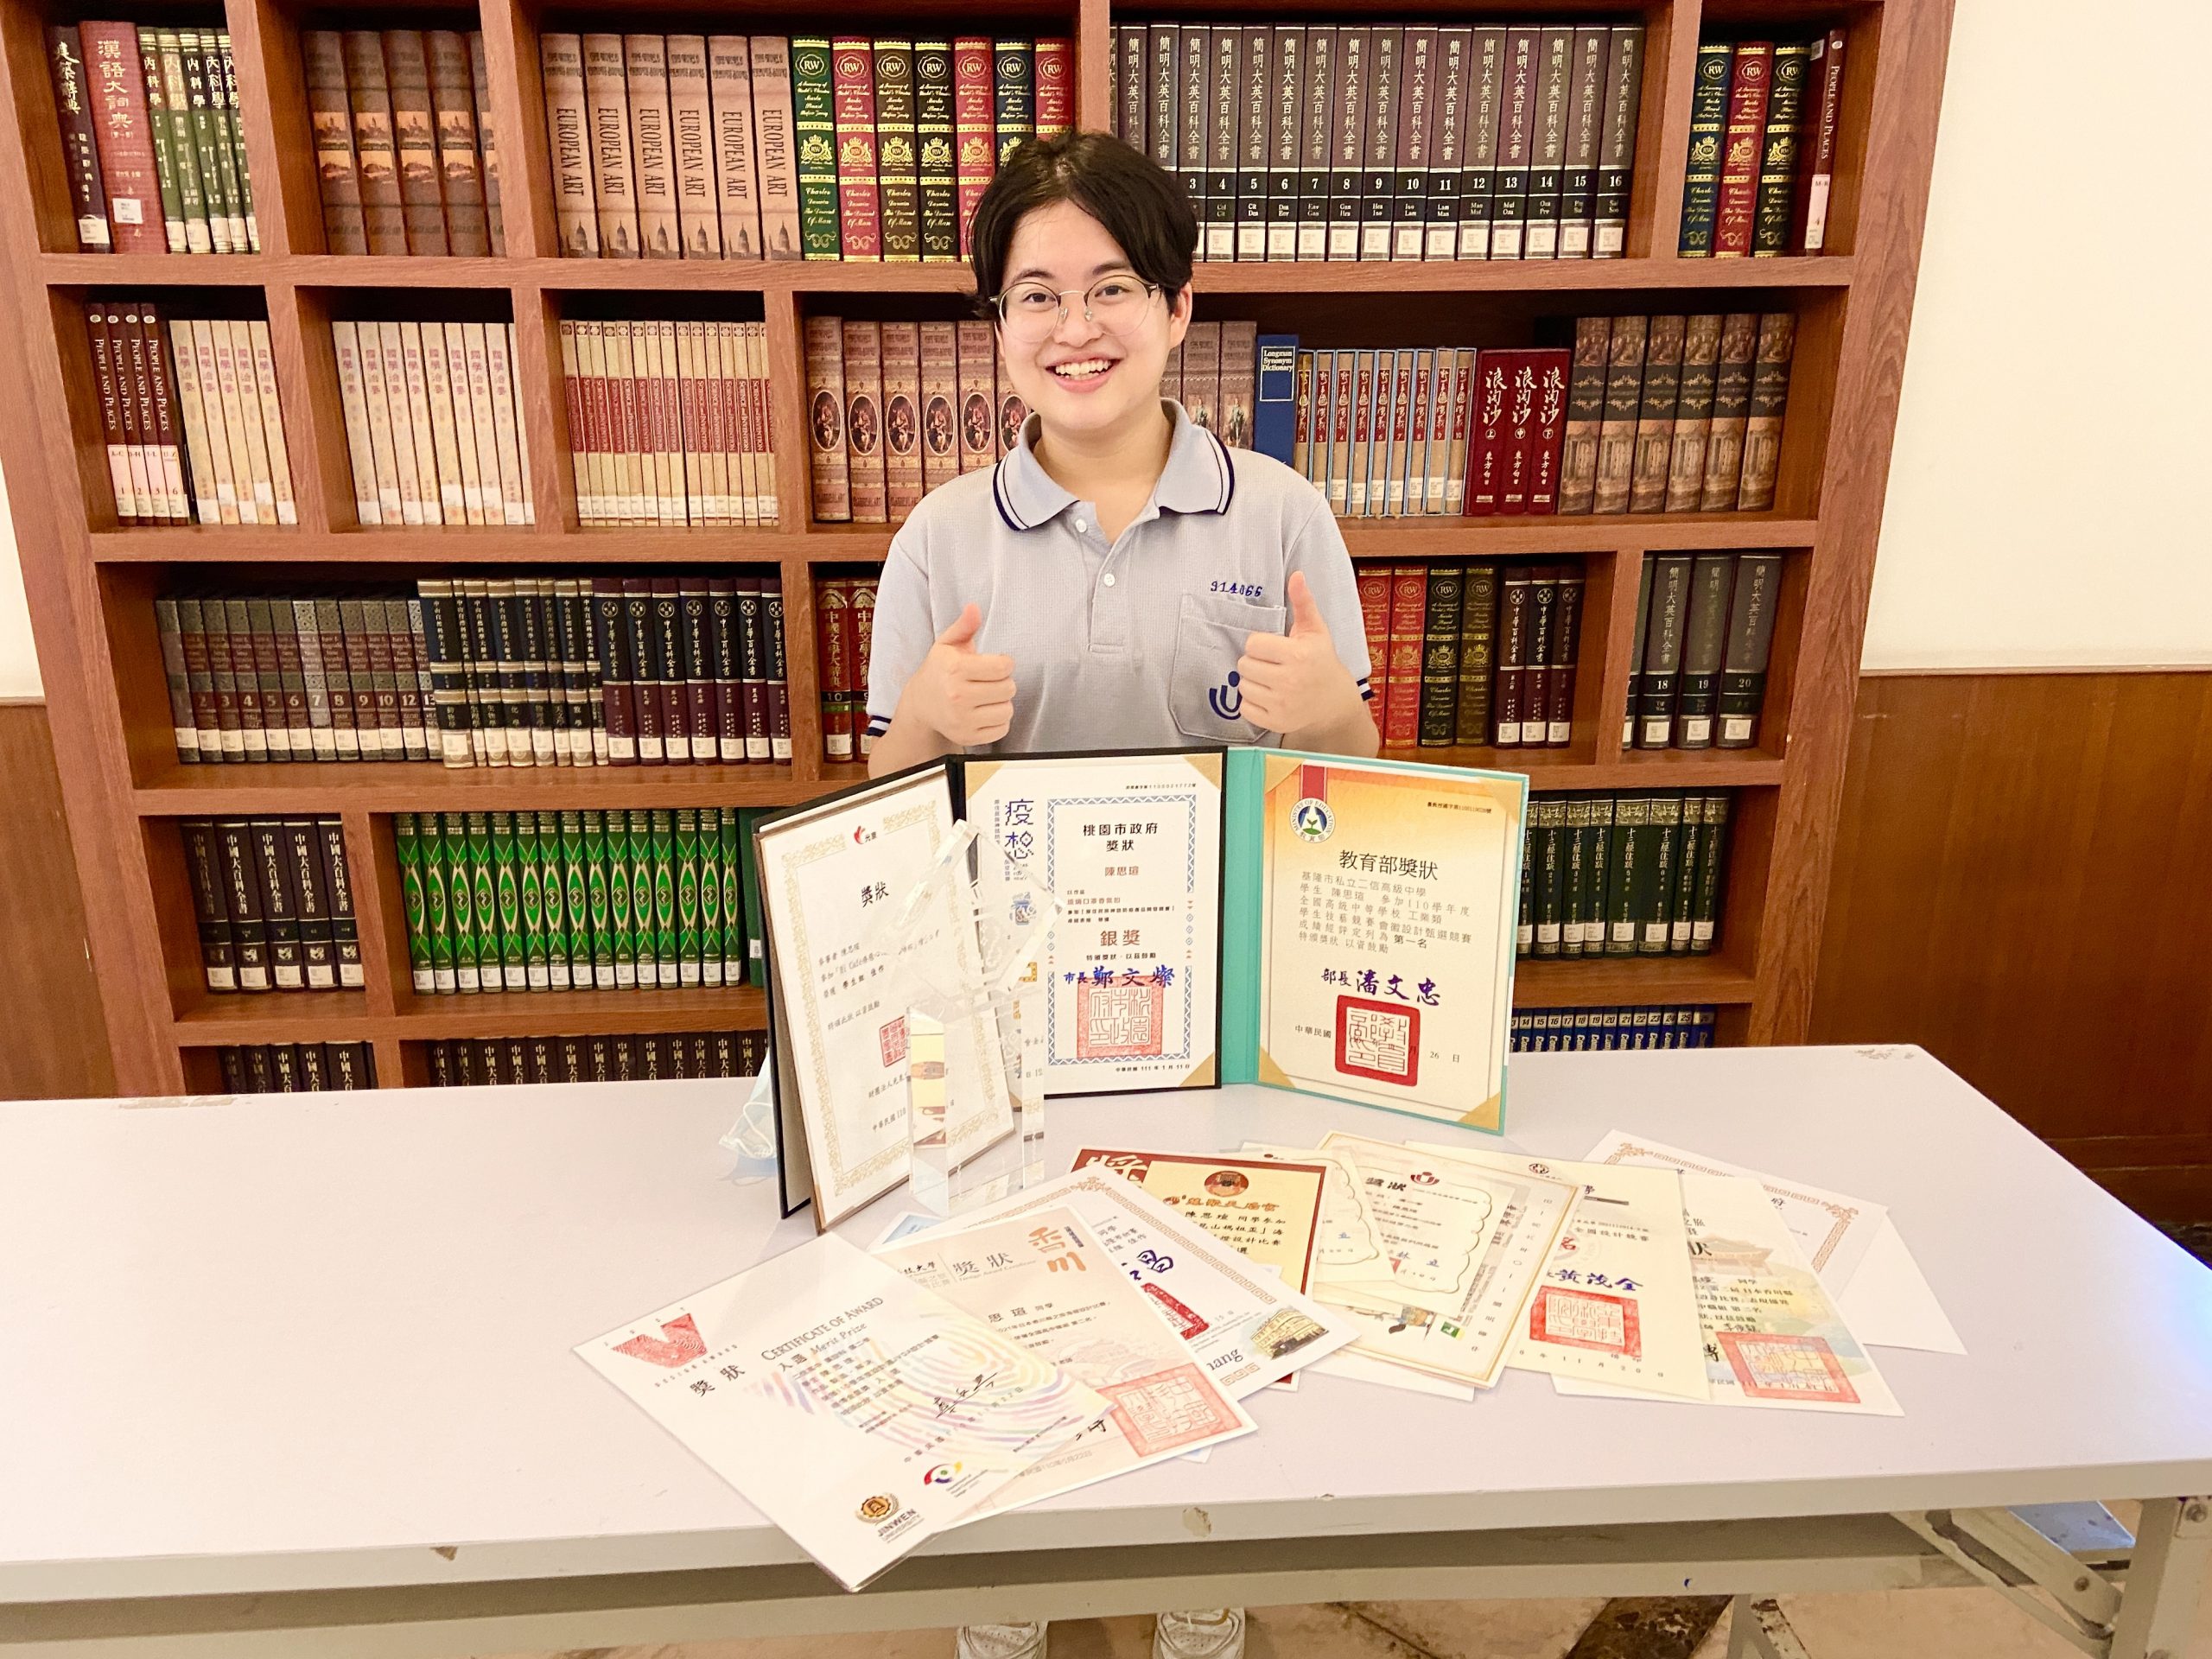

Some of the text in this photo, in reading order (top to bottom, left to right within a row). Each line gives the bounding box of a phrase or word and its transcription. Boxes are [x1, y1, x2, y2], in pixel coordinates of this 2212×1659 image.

[804, 60, 819, 69] RW
[843, 63, 860, 72] RW
[885, 63, 901, 72] RW
[926, 63, 942, 72] RW
[967, 63, 982, 72] RW
[1006, 63, 1021, 72] RW
[98, 40, 132, 129] 漢語大詞典
[144, 56, 162, 105] 內科學
[187, 57, 206, 107] 內科學
[206, 56, 226, 109] 內科學
[1158, 36, 1170, 159] 簡明大英百科全書
[1188, 37, 1201, 160] 簡明大英百科全書
[1218, 38, 1231, 160] 簡明大英百科全書
[1250, 37, 1264, 159] 簡明大英百科全書
[1281, 38, 1296, 160] 簡明大英百科全書
[1313, 38, 1327, 159] 簡明大英百科全書
[1344, 39, 1359, 160] 簡明大英百科全書
[556, 108, 584, 195] EUROPEAN ART
[598, 107, 624, 195] EUROPEAN ART
[639, 109, 665, 195] EUROPEAN ART
[679, 110, 705, 197] EUROPEAN ART
[722, 111, 747, 199] EUROPEAN ART
[762, 110, 787, 197] EUROPEAN ART
[1190, 178, 1196, 189] 3
[1219, 178, 1225, 189] 4
[1251, 178, 1257, 189] 5
[1281, 179, 1288, 189] 6
[1312, 178, 1318, 189] 7
[1344, 179, 1350, 189] 8
[1376, 178, 1382, 189] 9
[1407, 178, 1420, 189] 10
[1440, 179, 1451, 190] 11
[1473, 178, 1485, 188] 12
[1505, 176, 1517, 188] 13
[1540, 176, 1553, 188] 14
[1574, 175, 1586, 187] 15
[1610, 175, 1622, 187] 16
[1483, 366, 1507, 426] 浪淘沙
[1512, 365, 1536, 425] 浪淘沙
[1540, 365, 1565, 425] 浪淘沙
[607, 620, 619, 677] 中華百科全書
[1657, 681, 1668, 690] 18
[1698, 680, 1708, 689] 19
[1738, 678, 1751, 688] 20
[221, 696, 230, 706] 3
[244, 695, 252, 706] 4
[289, 696, 299, 705] 6
[312, 695, 321, 705] 7
[334, 696, 344, 706] 8
[359, 696, 368, 706] 9
[379, 696, 393, 706] 10
[402, 695, 416, 705] 12
[1084, 823, 1158, 836] 桃園市政府
[1106, 839, 1135, 852] 獎狀
[1105, 866, 1139, 877] 陳思瑄
[1338, 849, 1439, 881] 教育部獎狀
[1302, 872, 1426, 897] 基隆市私立二信高級中學
[861, 881, 889, 907] 獎狀
[1300, 883, 1323, 895] 學生
[1332, 887, 1364, 901] 陳思瑄
[1300, 896, 1441, 925] 全國高級中等學校 工業類
[1100, 930, 1141, 946] 銀獎
[1394, 934, 1427, 949] 第一名
[1321, 968, 1440, 1007] 部長 潘文忠
[1295, 1024, 1459, 1063] 中華民國 26 日
[954, 1253, 1014, 1276] 獎狀
[760, 1319, 830, 1363] CERTIFICATE
[828, 1314, 845, 1329] OF
[844, 1294, 885, 1321] AWARD
[810, 1334, 840, 1356] Merit
[839, 1320, 868, 1340] Prize
[690, 1363, 746, 1397] 獎狀
